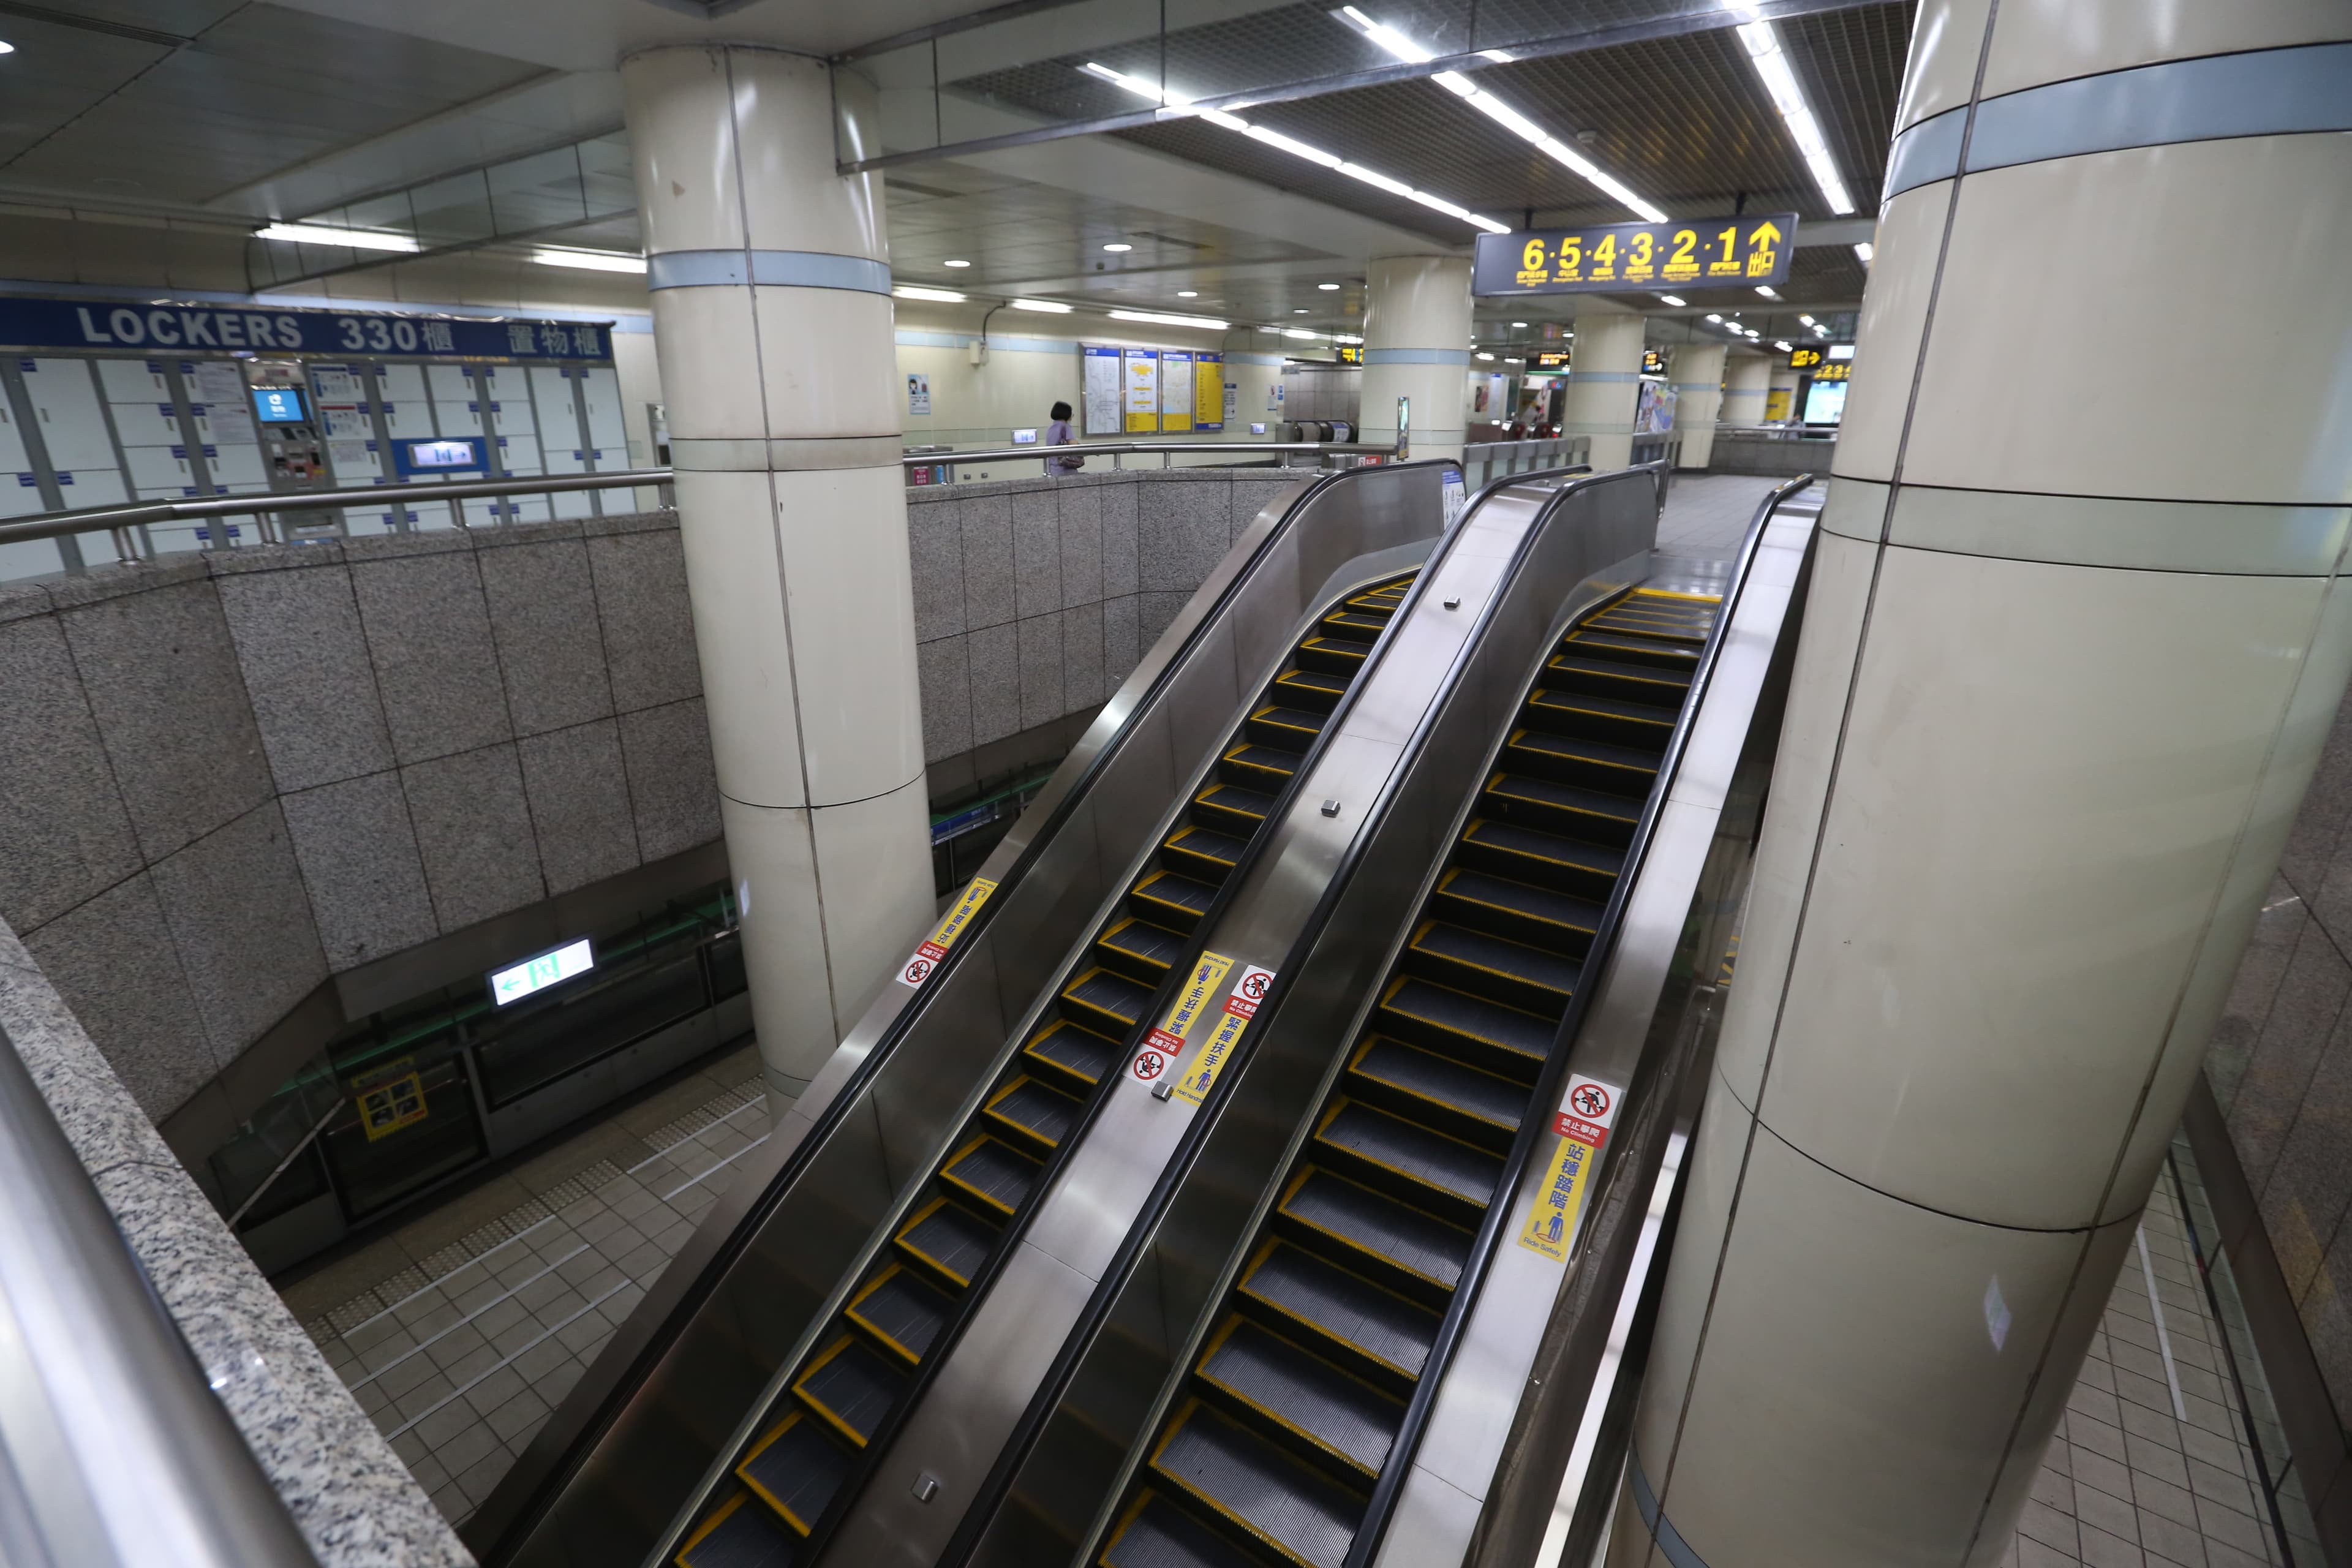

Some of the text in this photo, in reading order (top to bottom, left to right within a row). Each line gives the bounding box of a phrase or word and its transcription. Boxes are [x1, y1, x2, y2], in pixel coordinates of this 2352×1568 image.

[1747, 251, 1776, 277] 出口
[77, 307, 303, 349] LOCKERS
[507, 324, 601, 356] 置物櫃
[1170, 987, 1204, 1035] 緊握扶手
[1204, 1016, 1242, 1067] 緊握扶手
[1561, 1117, 1601, 1138] 禁止攀爬
[1570, 1129, 1596, 1144] Climbing
[1548, 1143, 1586, 1210] 站穩踏階
[1523, 1237, 1562, 1257] Ride Safely
